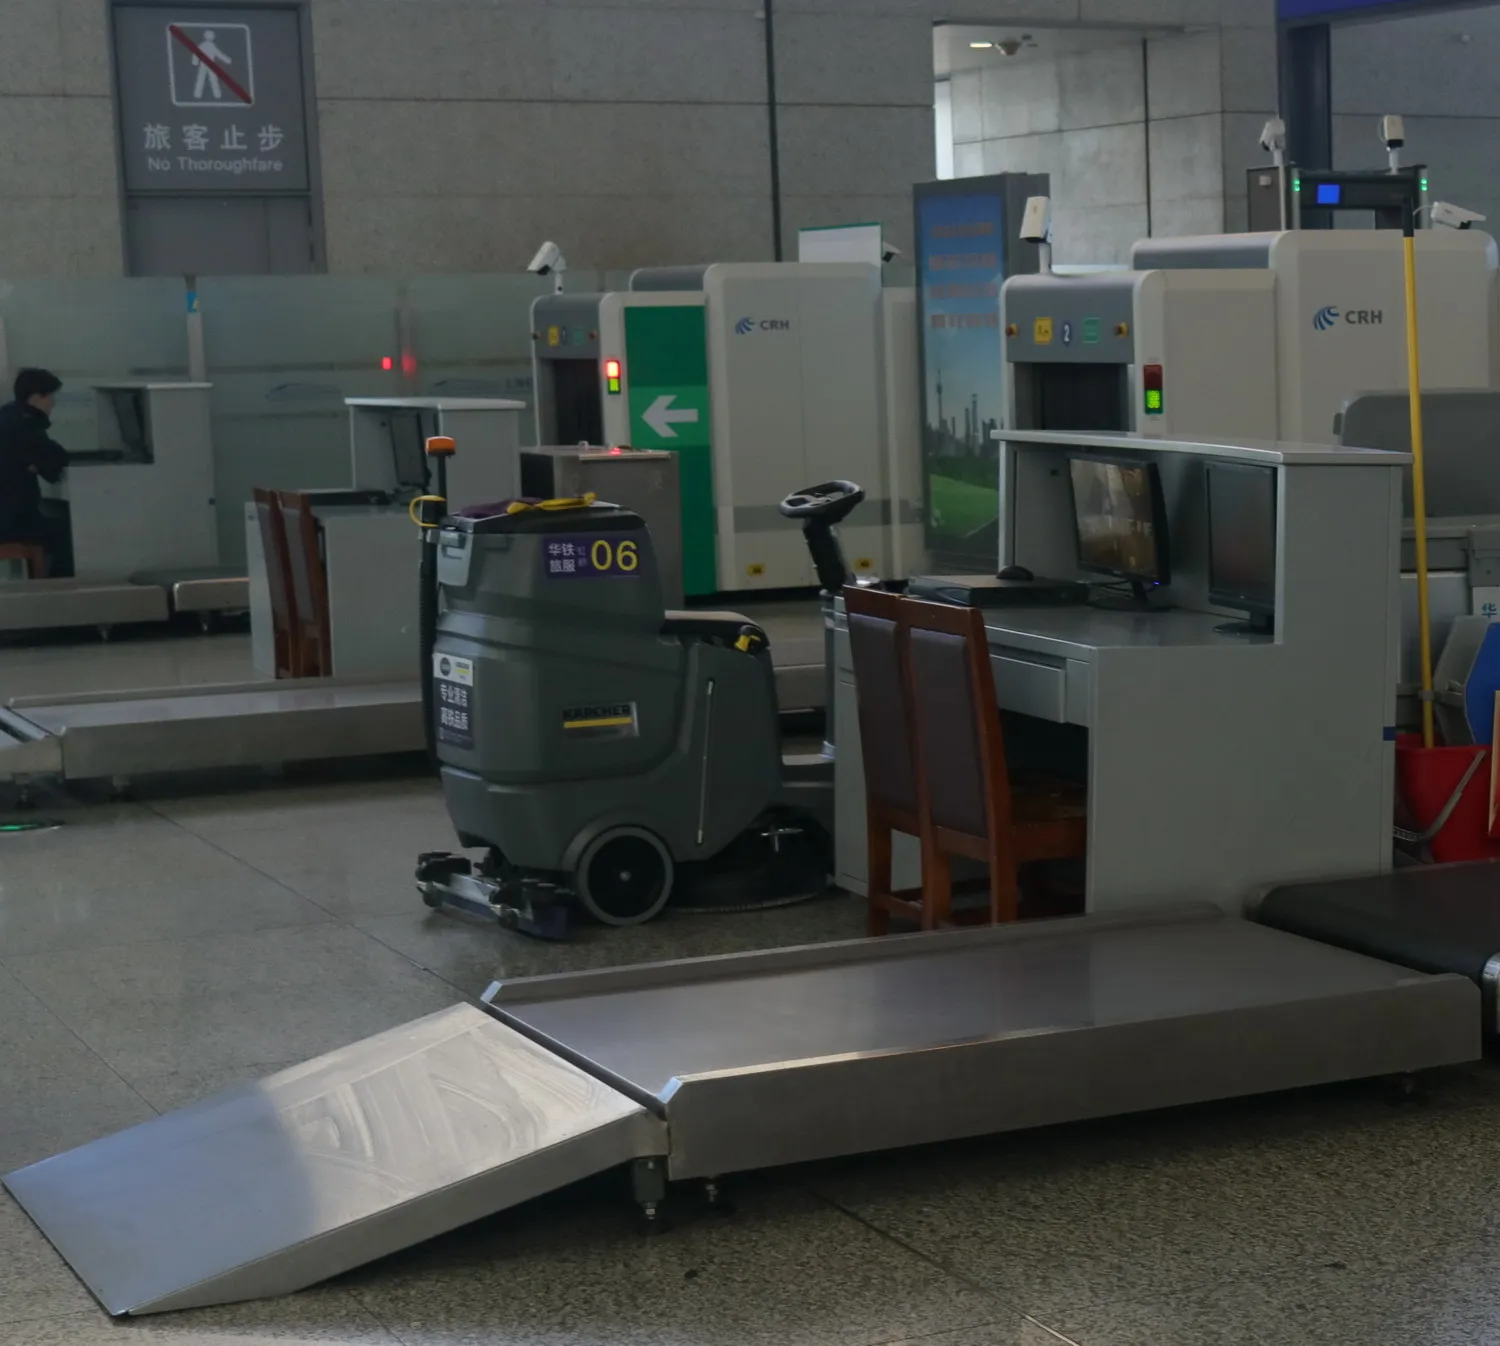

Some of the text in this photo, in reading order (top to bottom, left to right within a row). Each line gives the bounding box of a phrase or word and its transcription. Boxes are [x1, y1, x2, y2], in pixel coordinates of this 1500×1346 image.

[143, 123, 284, 151] 旅客止步
[149, 156, 283, 174] No Thoroughfare
[760, 319, 789, 331] CRH
[1345, 309, 1383, 324] CRH
[591, 540, 638, 571] 06
